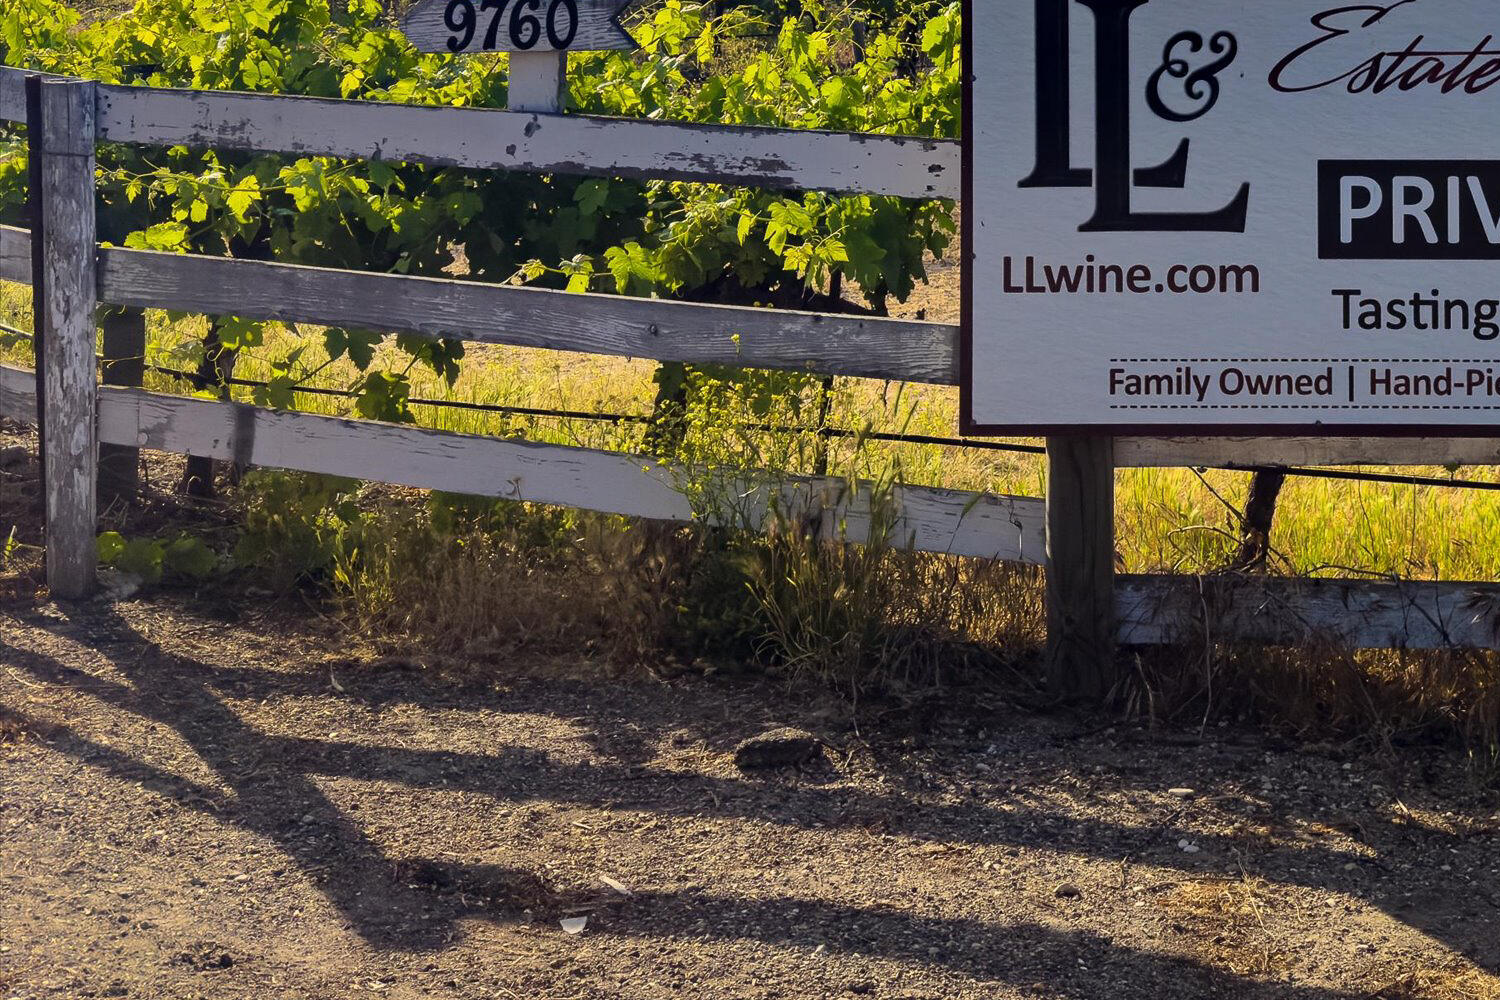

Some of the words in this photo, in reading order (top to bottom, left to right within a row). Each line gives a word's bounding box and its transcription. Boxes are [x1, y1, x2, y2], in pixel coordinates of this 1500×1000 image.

[1004, 255, 1260, 293] LLwine.com
[1332, 289, 1500, 341] Tasting
[1110, 367, 1211, 402] Family
[1220, 367, 1333, 396] Owned
